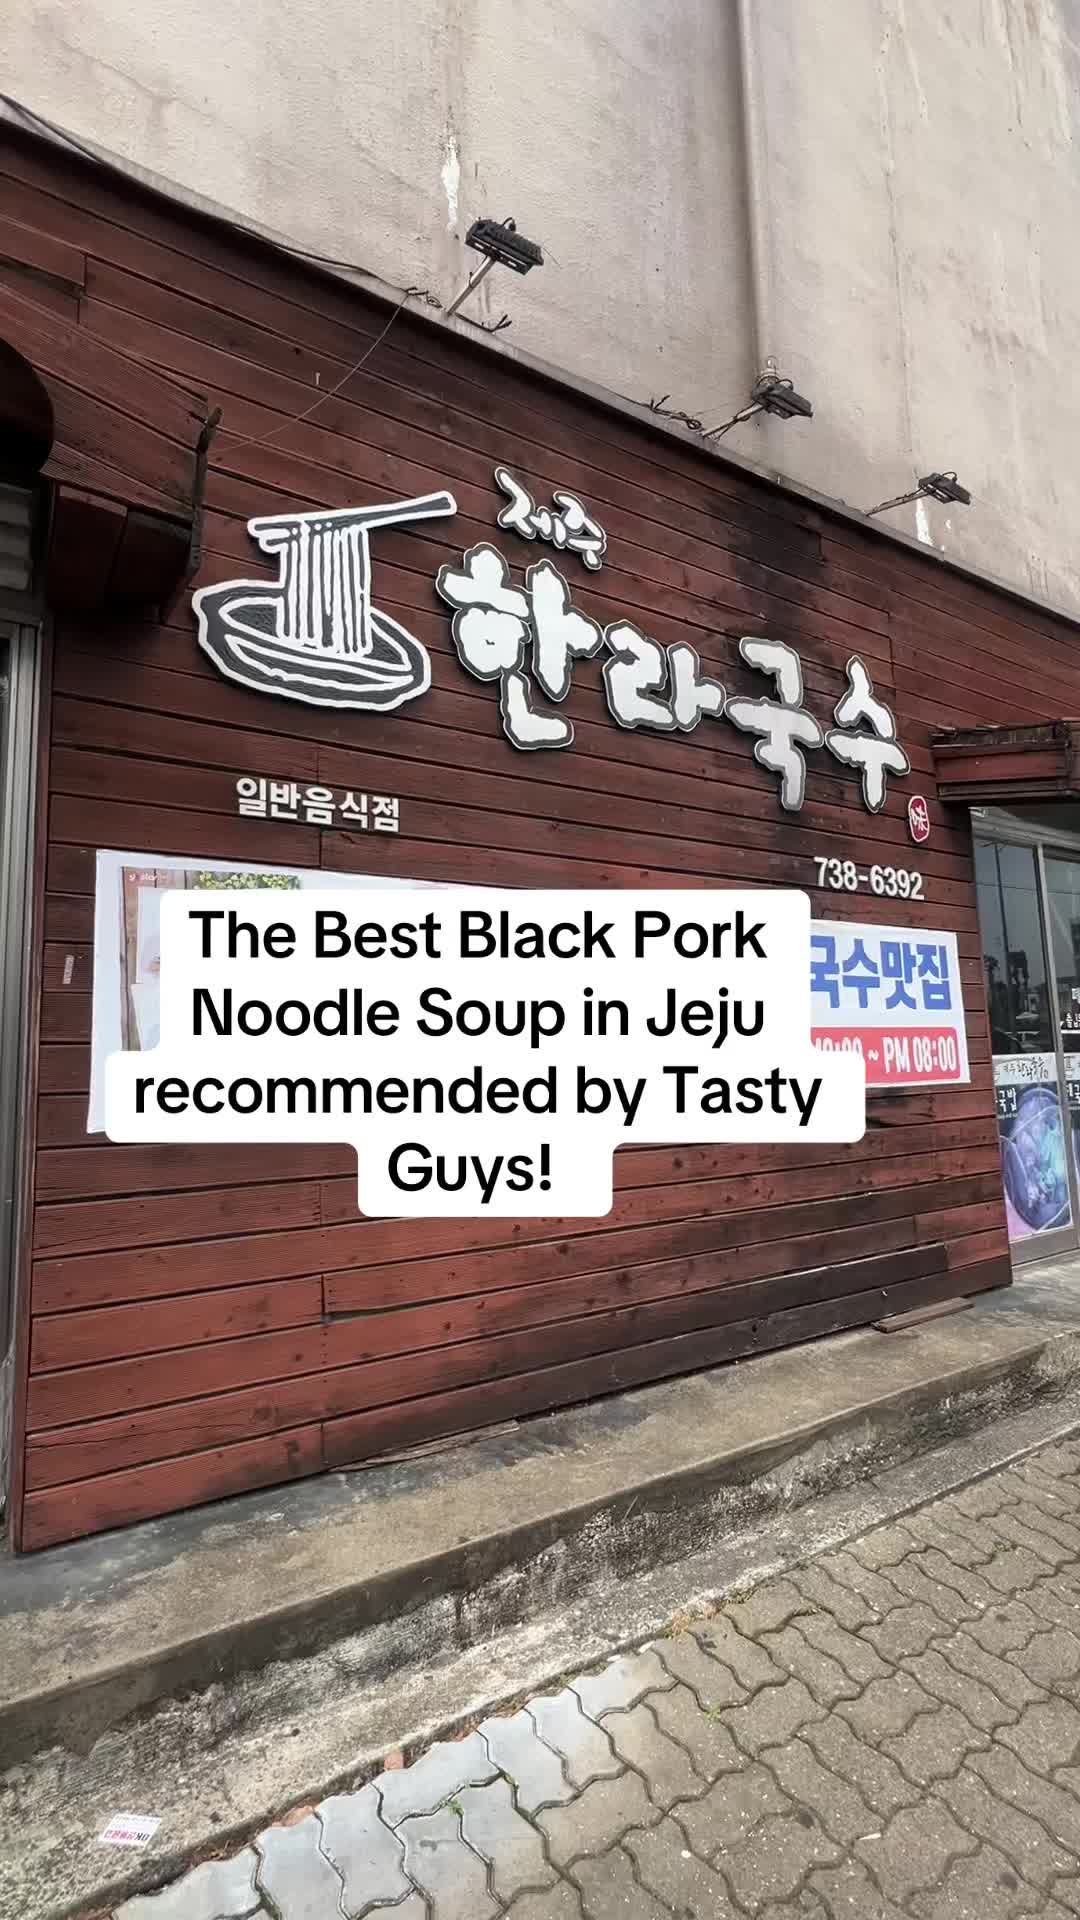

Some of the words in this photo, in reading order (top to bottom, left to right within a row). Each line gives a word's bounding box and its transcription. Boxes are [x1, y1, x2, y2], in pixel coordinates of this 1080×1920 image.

[495, 467, 606, 570] 제주
[436, 542, 909, 812] 한라국수
[236, 777, 399, 832] 일반음식점
[814, 856, 924, 900] 738-6392
[882, 1036, 910, 1073] PM
[912, 1035, 957, 1072] 08:00
